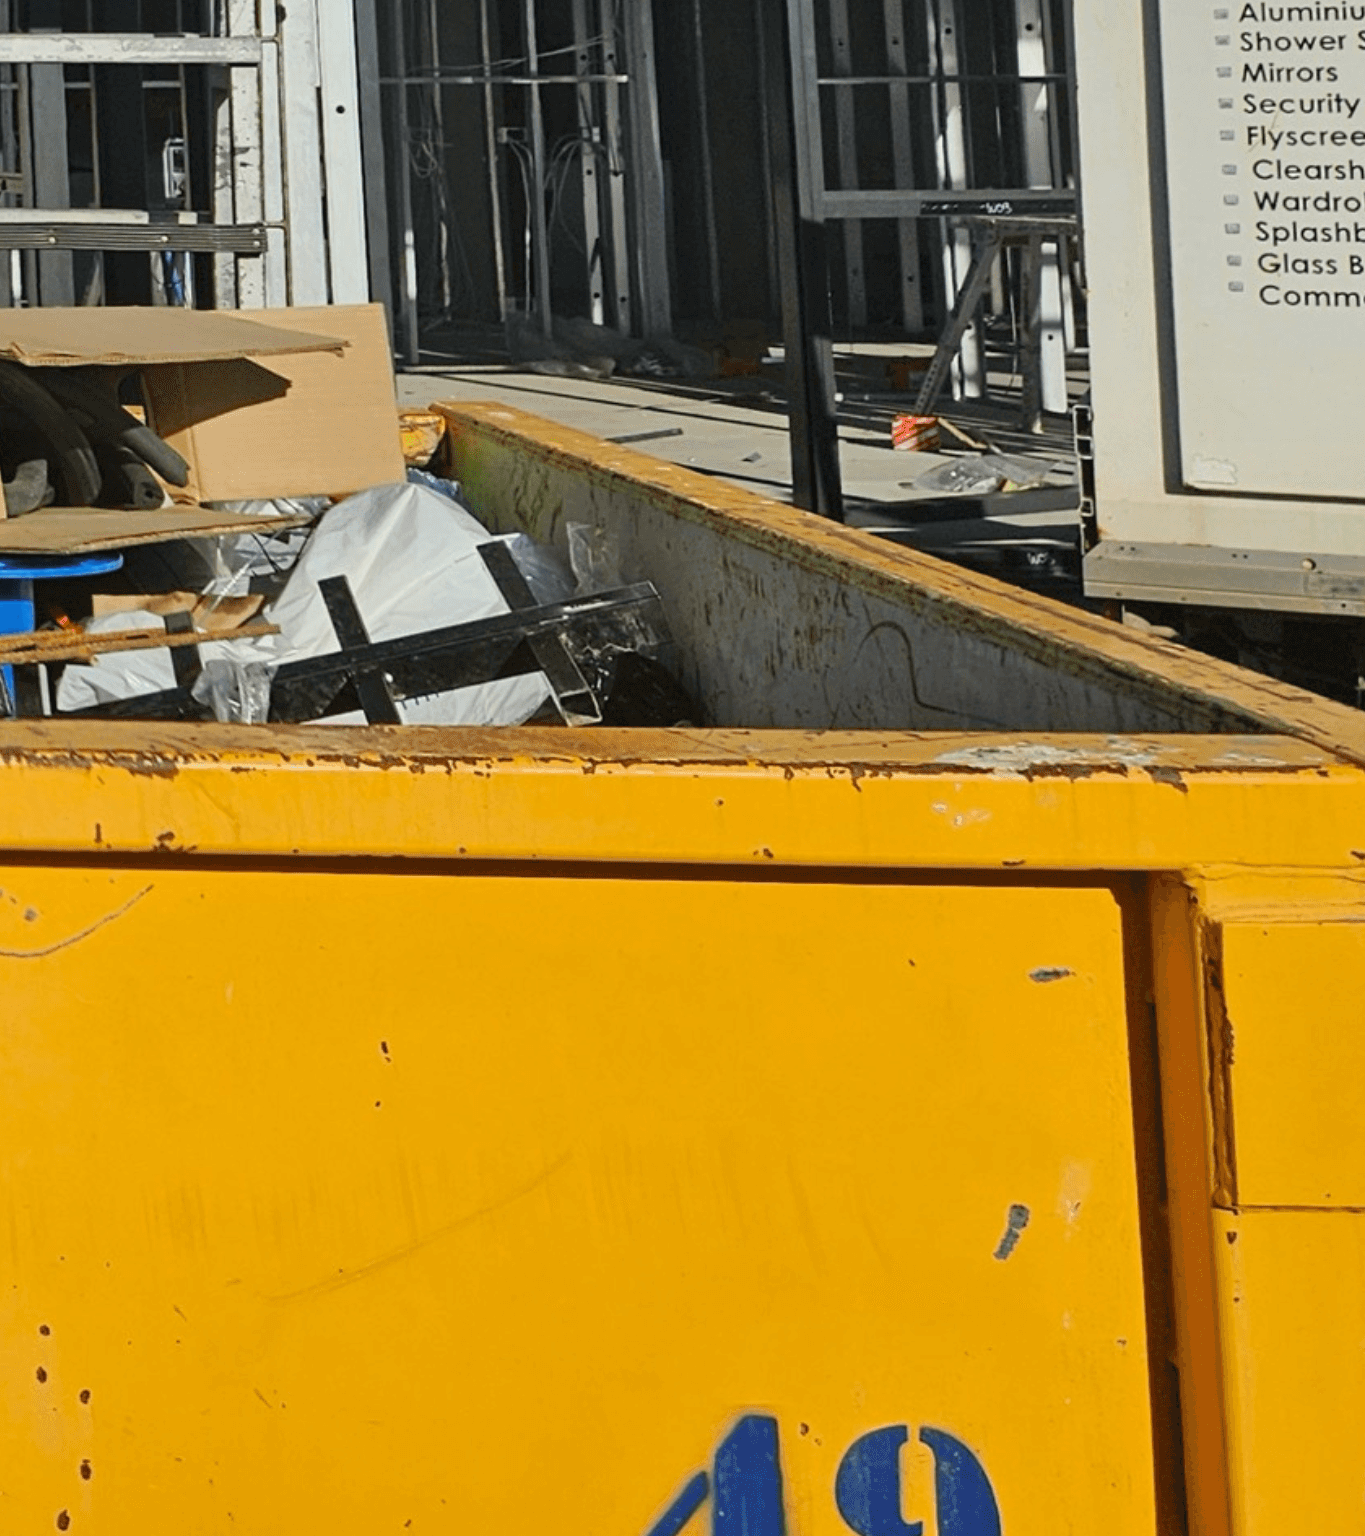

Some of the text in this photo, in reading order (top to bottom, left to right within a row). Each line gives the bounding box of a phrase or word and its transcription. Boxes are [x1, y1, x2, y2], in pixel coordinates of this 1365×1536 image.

[1240, 31, 1346, 52] Shower
[1242, 63, 1338, 83] Mirrors
[1243, 93, 1360, 119] Security
[1247, 125, 1365, 151] Flyscree
[1252, 159, 1365, 180] Clearsh
[1254, 191, 1365, 213] Wardro
[1257, 252, 1338, 274] Glass
[1259, 285, 1365, 307] Comm
